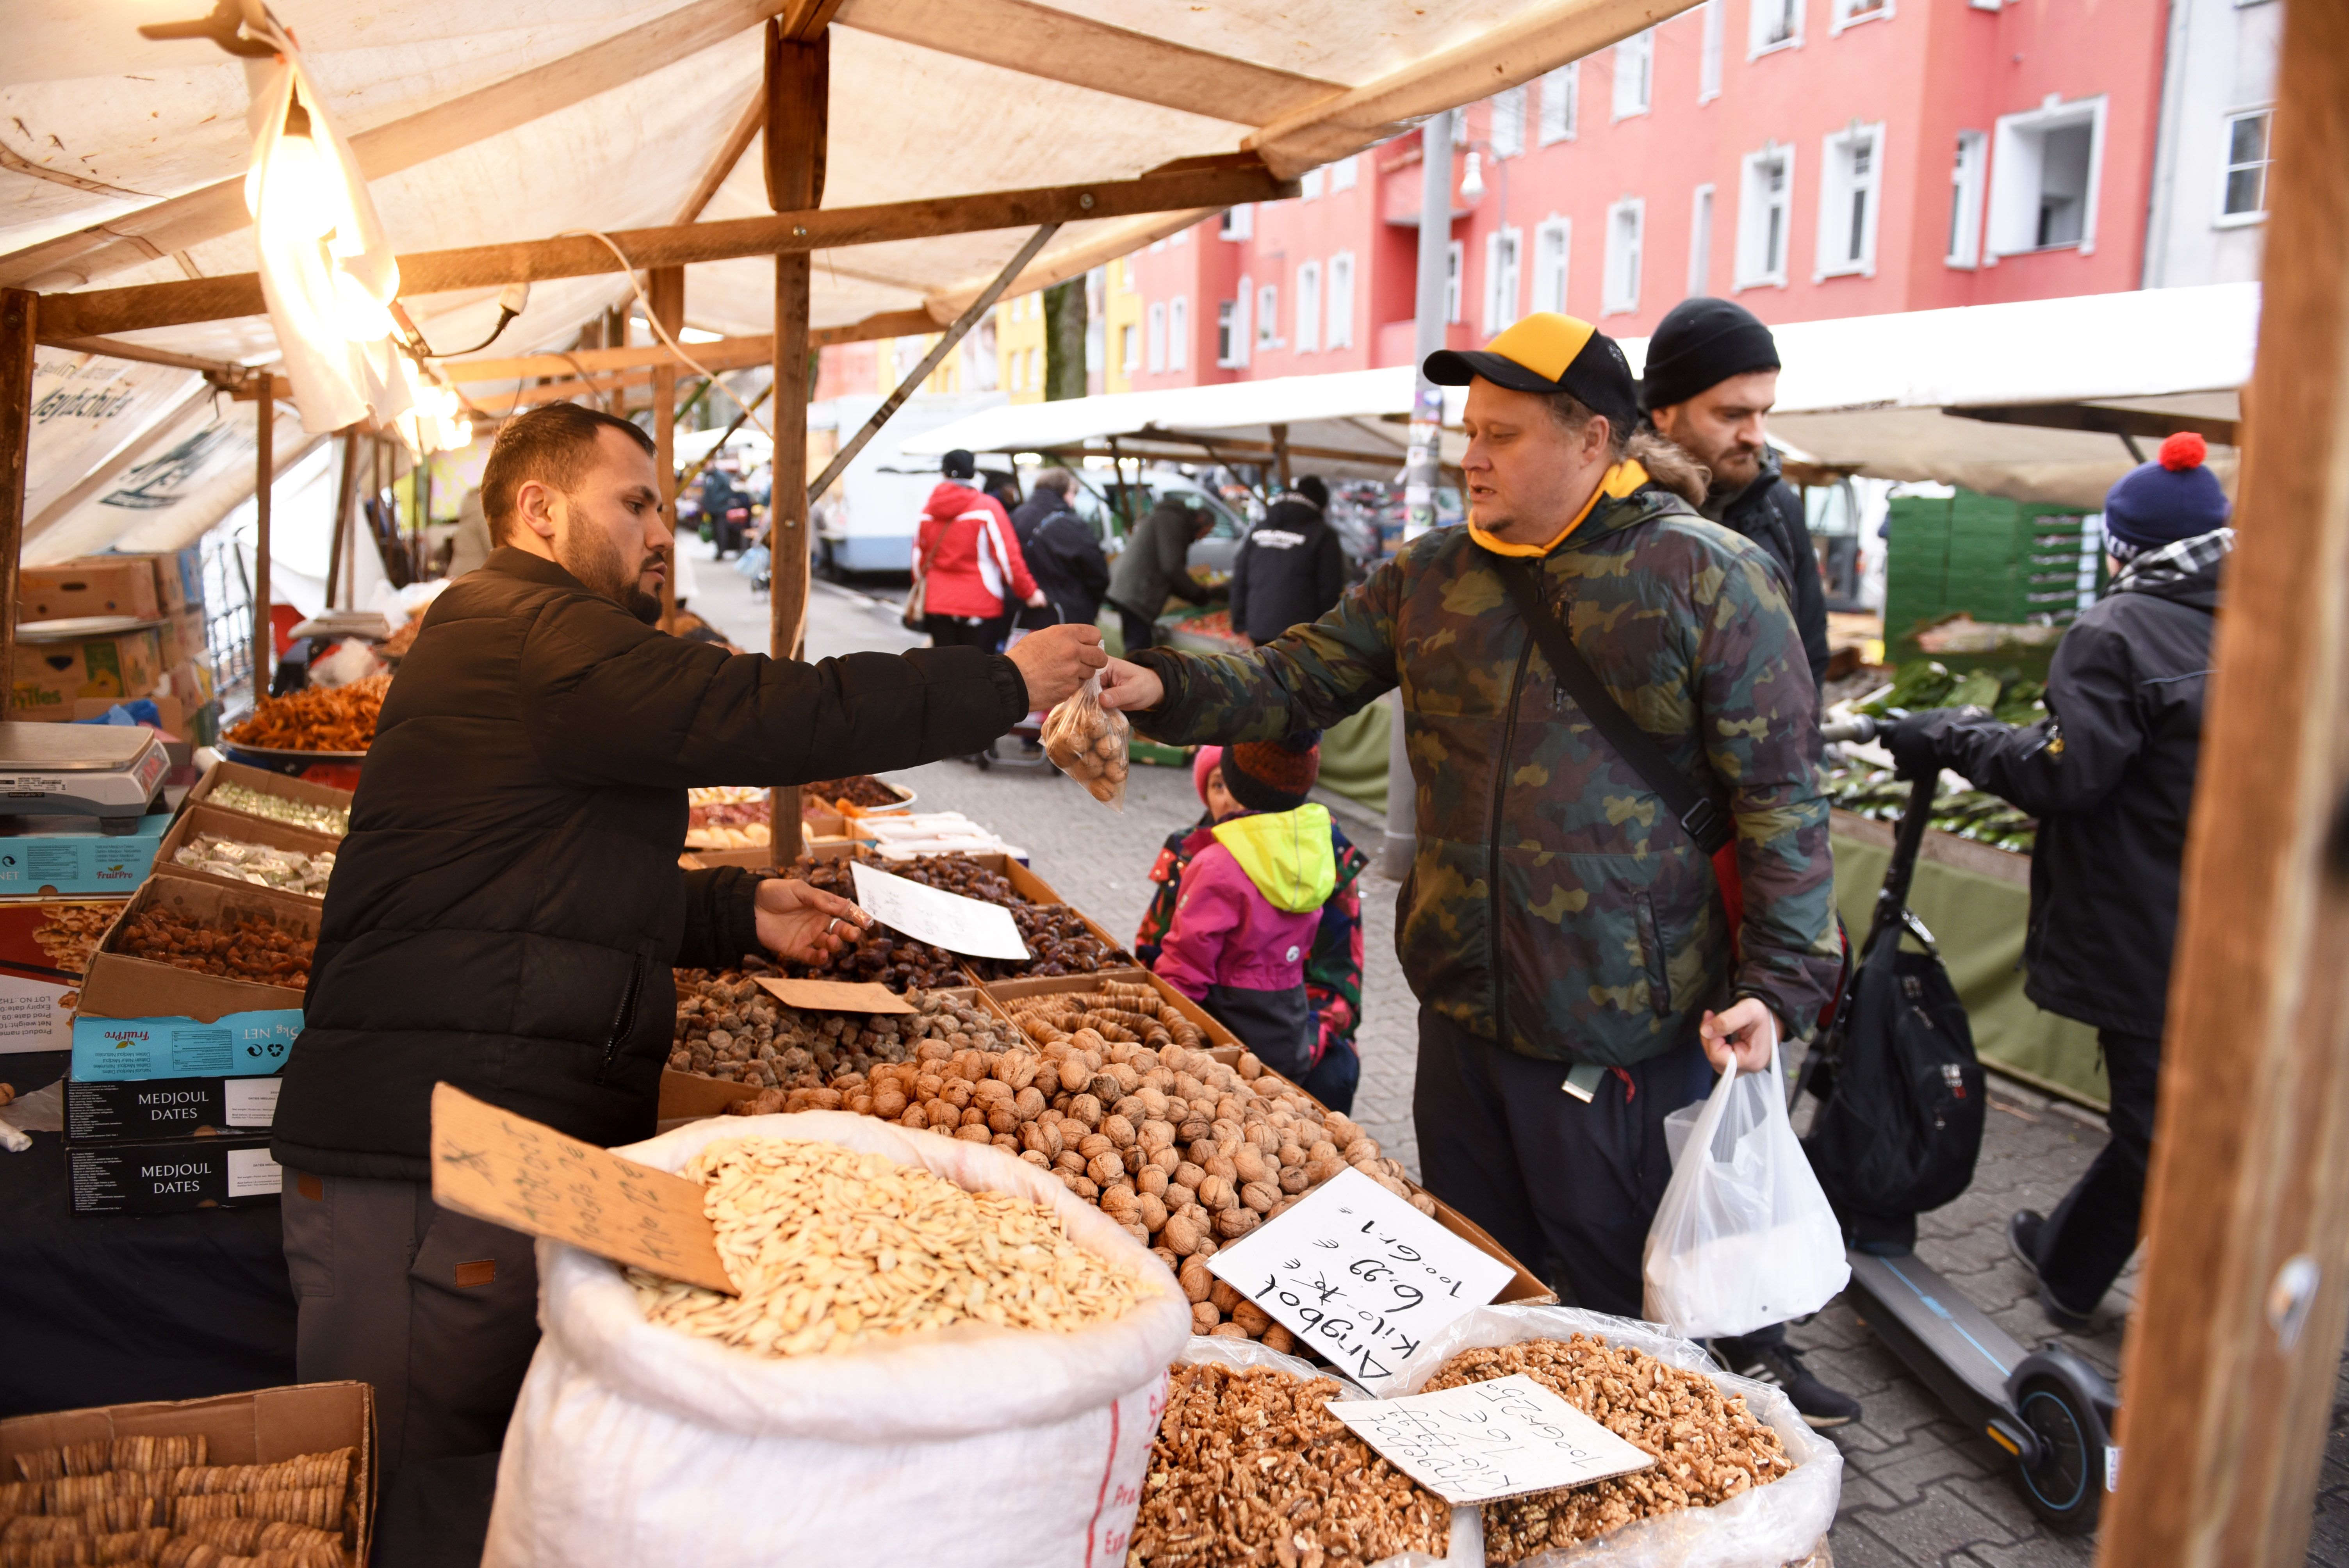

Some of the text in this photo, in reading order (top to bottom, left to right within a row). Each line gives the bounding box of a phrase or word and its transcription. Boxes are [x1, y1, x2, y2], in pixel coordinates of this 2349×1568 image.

[96, 870, 133, 879] FruitPro
[104, 1031, 150, 1041] FruitPro
[242, 1028, 270, 1040] NET
[139, 1091, 209, 1105] MEDJOUL
[151, 1108, 198, 1121] DATES
[141, 1163, 212, 1177] MEDJOUL
[154, 1180, 200, 1194] DATES
[619, 1214, 683, 1266] Kilo
[1345, 1413, 1484, 1495] Angebot
